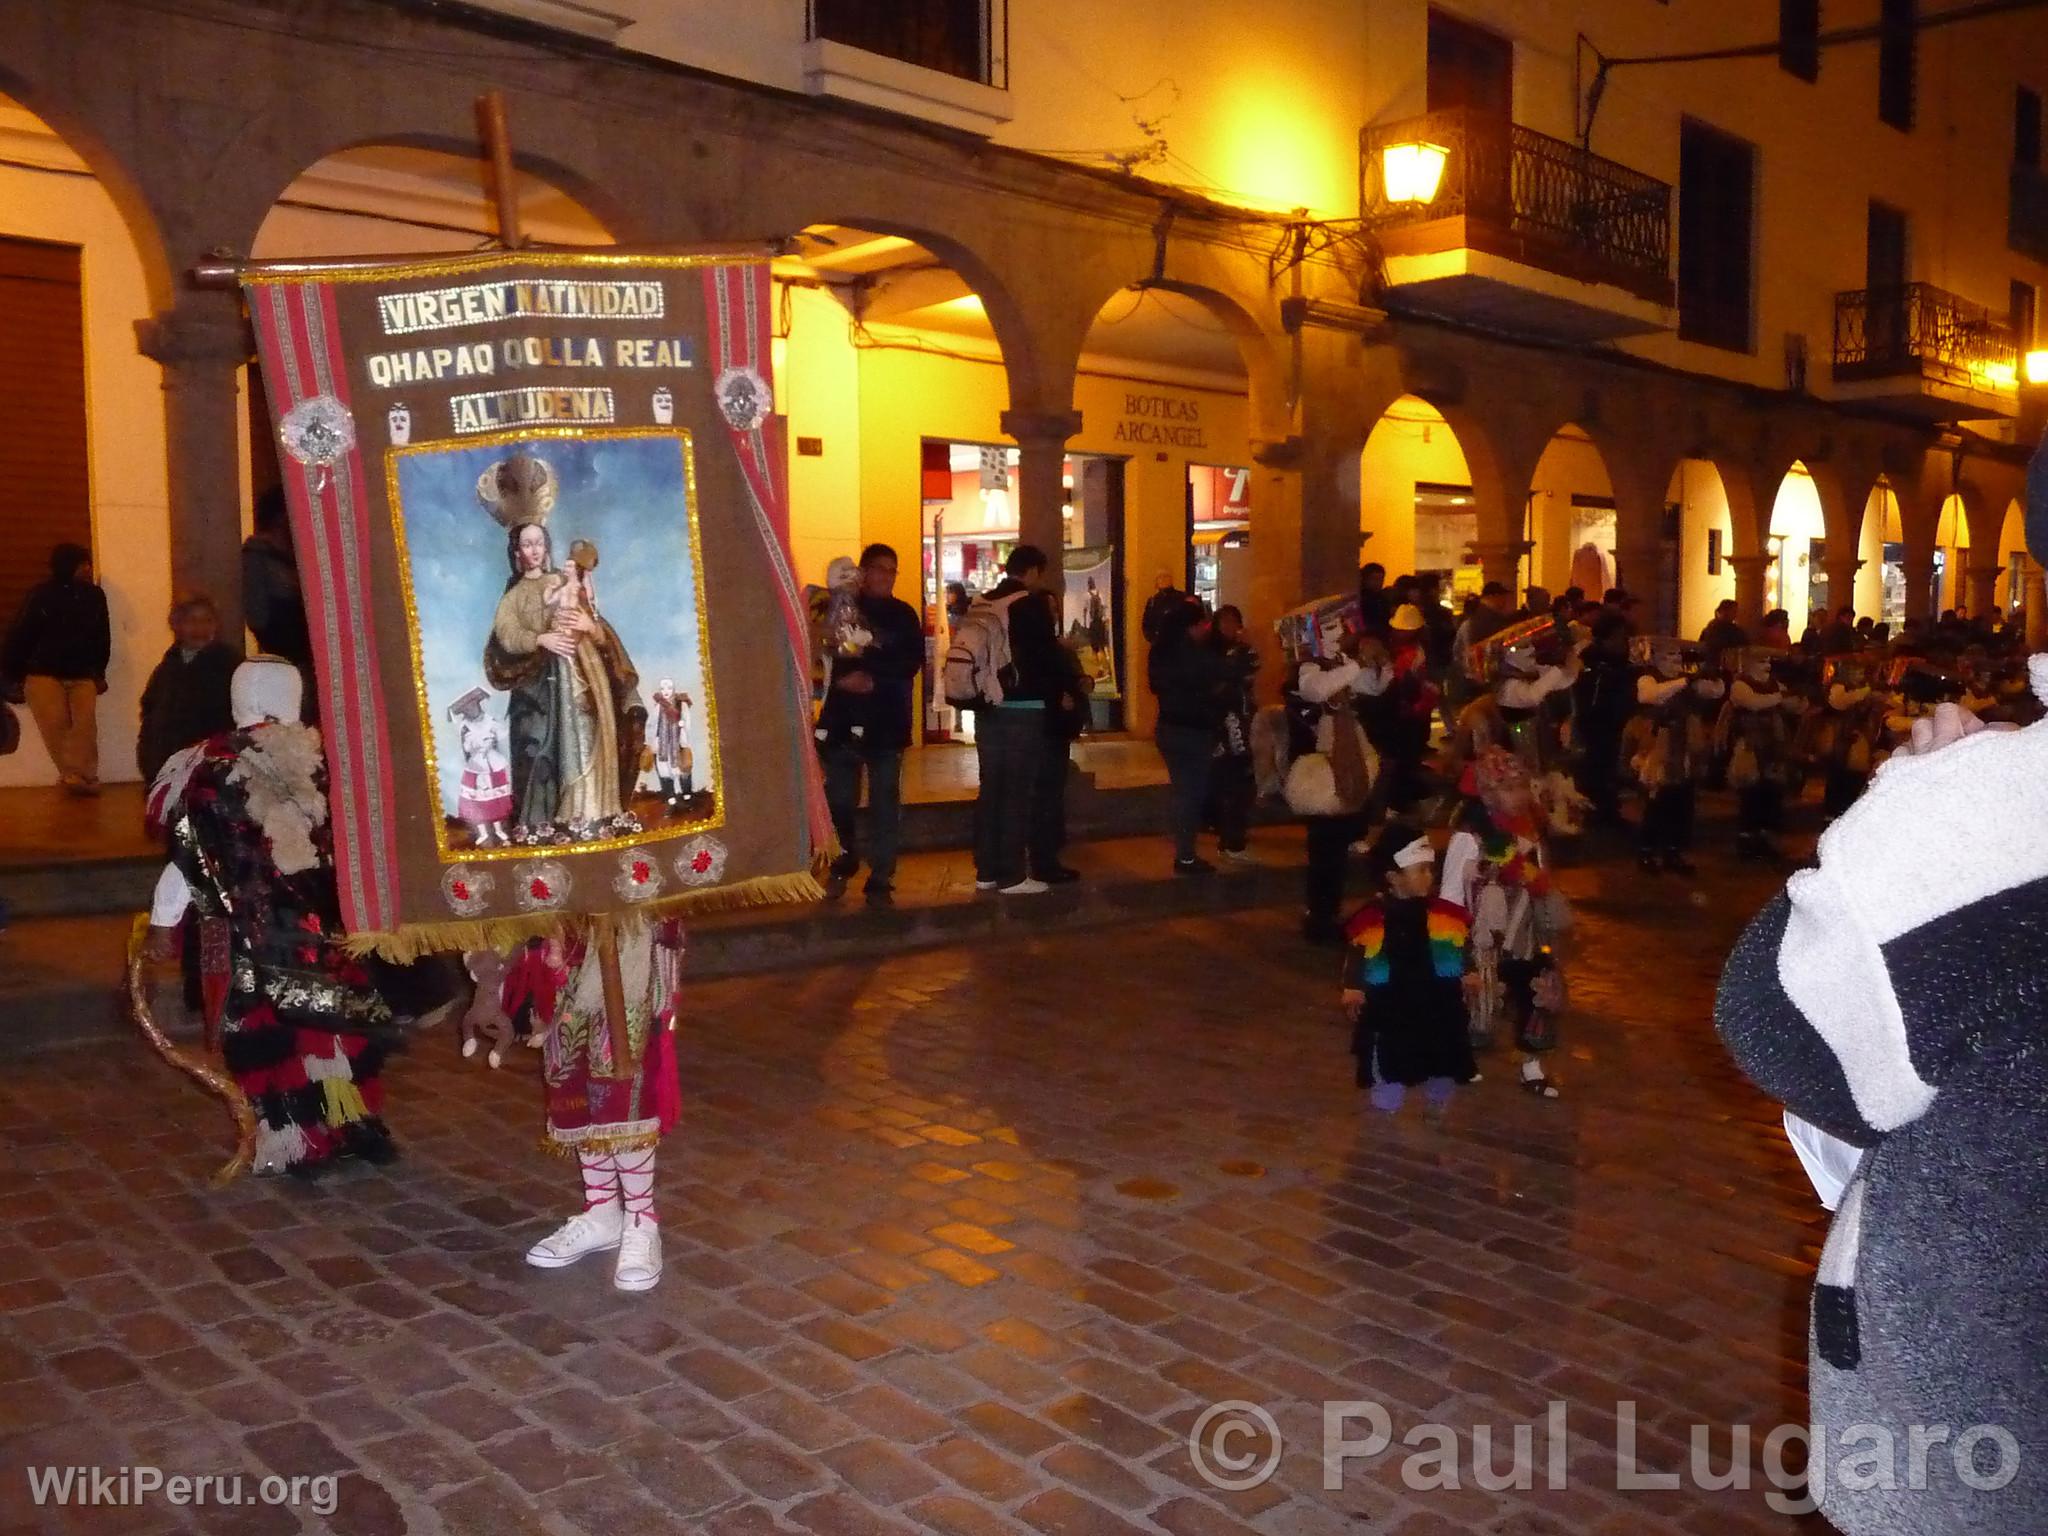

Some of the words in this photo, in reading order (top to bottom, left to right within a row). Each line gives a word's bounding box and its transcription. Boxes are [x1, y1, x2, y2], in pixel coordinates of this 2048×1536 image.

[385, 286, 506, 328] VIRGEN
[515, 283, 658, 315] NATIVIDAD
[369, 344, 495, 388] QHAPAQ
[503, 336, 603, 370] QOLLA
[616, 339, 692, 369] REAL
[459, 389, 610, 429] ALMUDENA
[1125, 393, 1199, 421] BOTICAS
[1114, 421, 1208, 448] ARCANGEL
